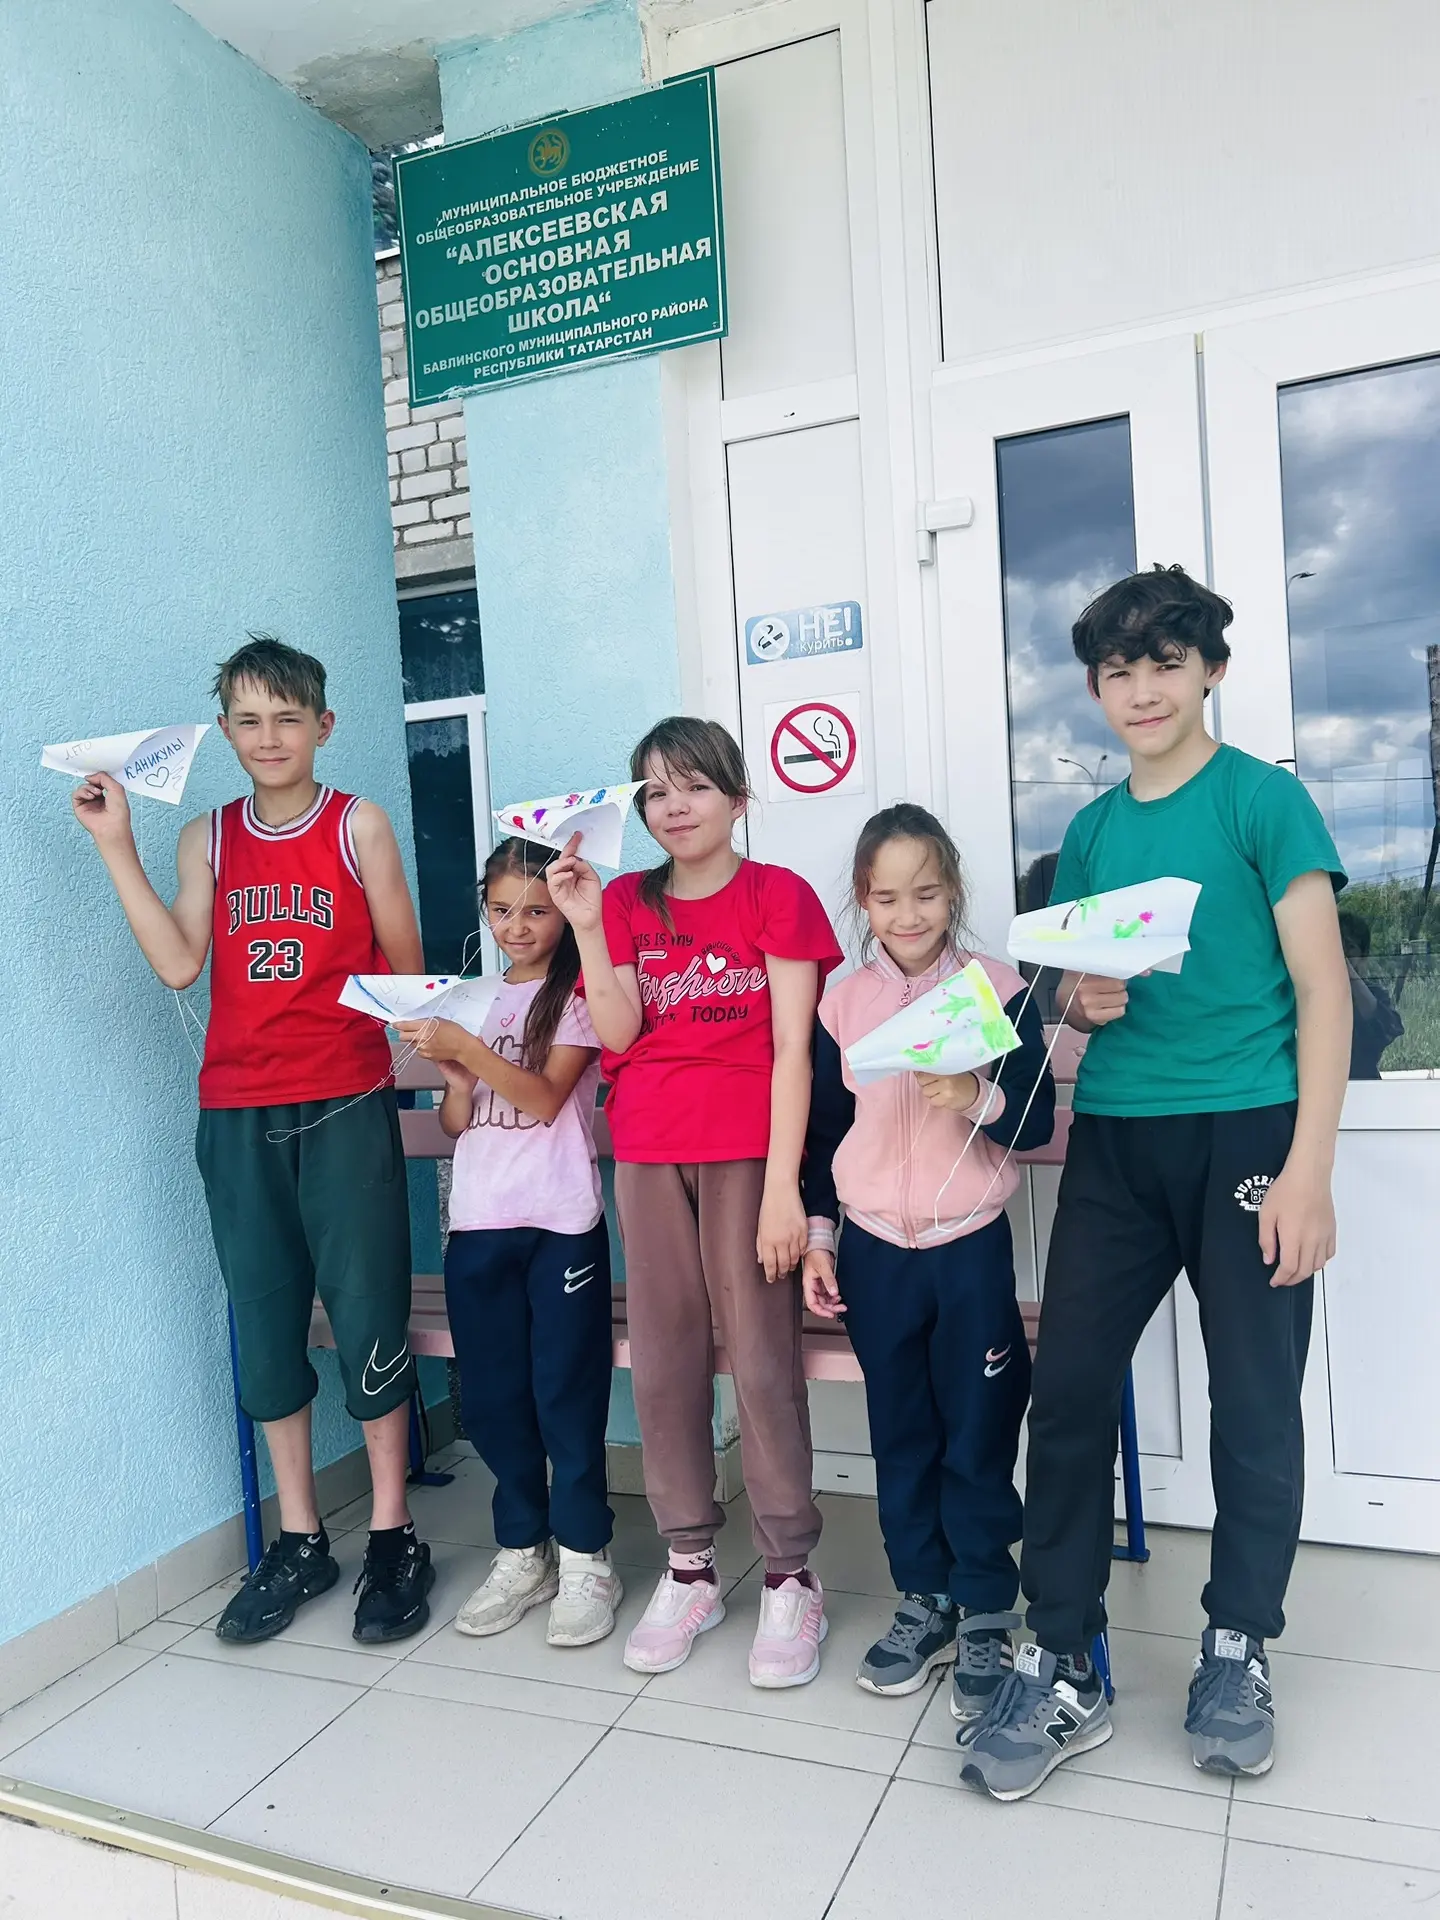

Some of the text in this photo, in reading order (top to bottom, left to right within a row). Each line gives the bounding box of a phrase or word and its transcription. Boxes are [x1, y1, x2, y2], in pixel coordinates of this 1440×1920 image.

[416, 158, 700, 245] ОБЩЕОБРАЗОВАТЕЛЬНОЕ УЧРЕЖДЕНИЕ
[441, 149, 668, 222] МУНИЦИПАЛЬНОЕ БЮДЖЕТНОЕ
[415, 236, 712, 329] ОБЩЕОБРАЗОВАТЕЛЬНАЯ
[484, 229, 631, 285] ОСНОВНАЯ
[423, 297, 709, 375] БАВЛИНСКОГО МУНИЦИПАЛЬНОГО РАЙОНА
[473, 327, 653, 379] РЕСПУБЛИКИ ТАТАРСТАН
[798, 606, 854, 646] НЕ!
[800, 635, 845, 653] курить
[124, 737, 185, 780] КАНИКУЛЫ
[226, 883, 333, 936] BULLS
[248, 938, 303, 982] 23
[637, 950, 767, 1014] Fashion
[1220, 1646, 1242, 1658] 574
[1043, 1705, 1081, 1750] N
